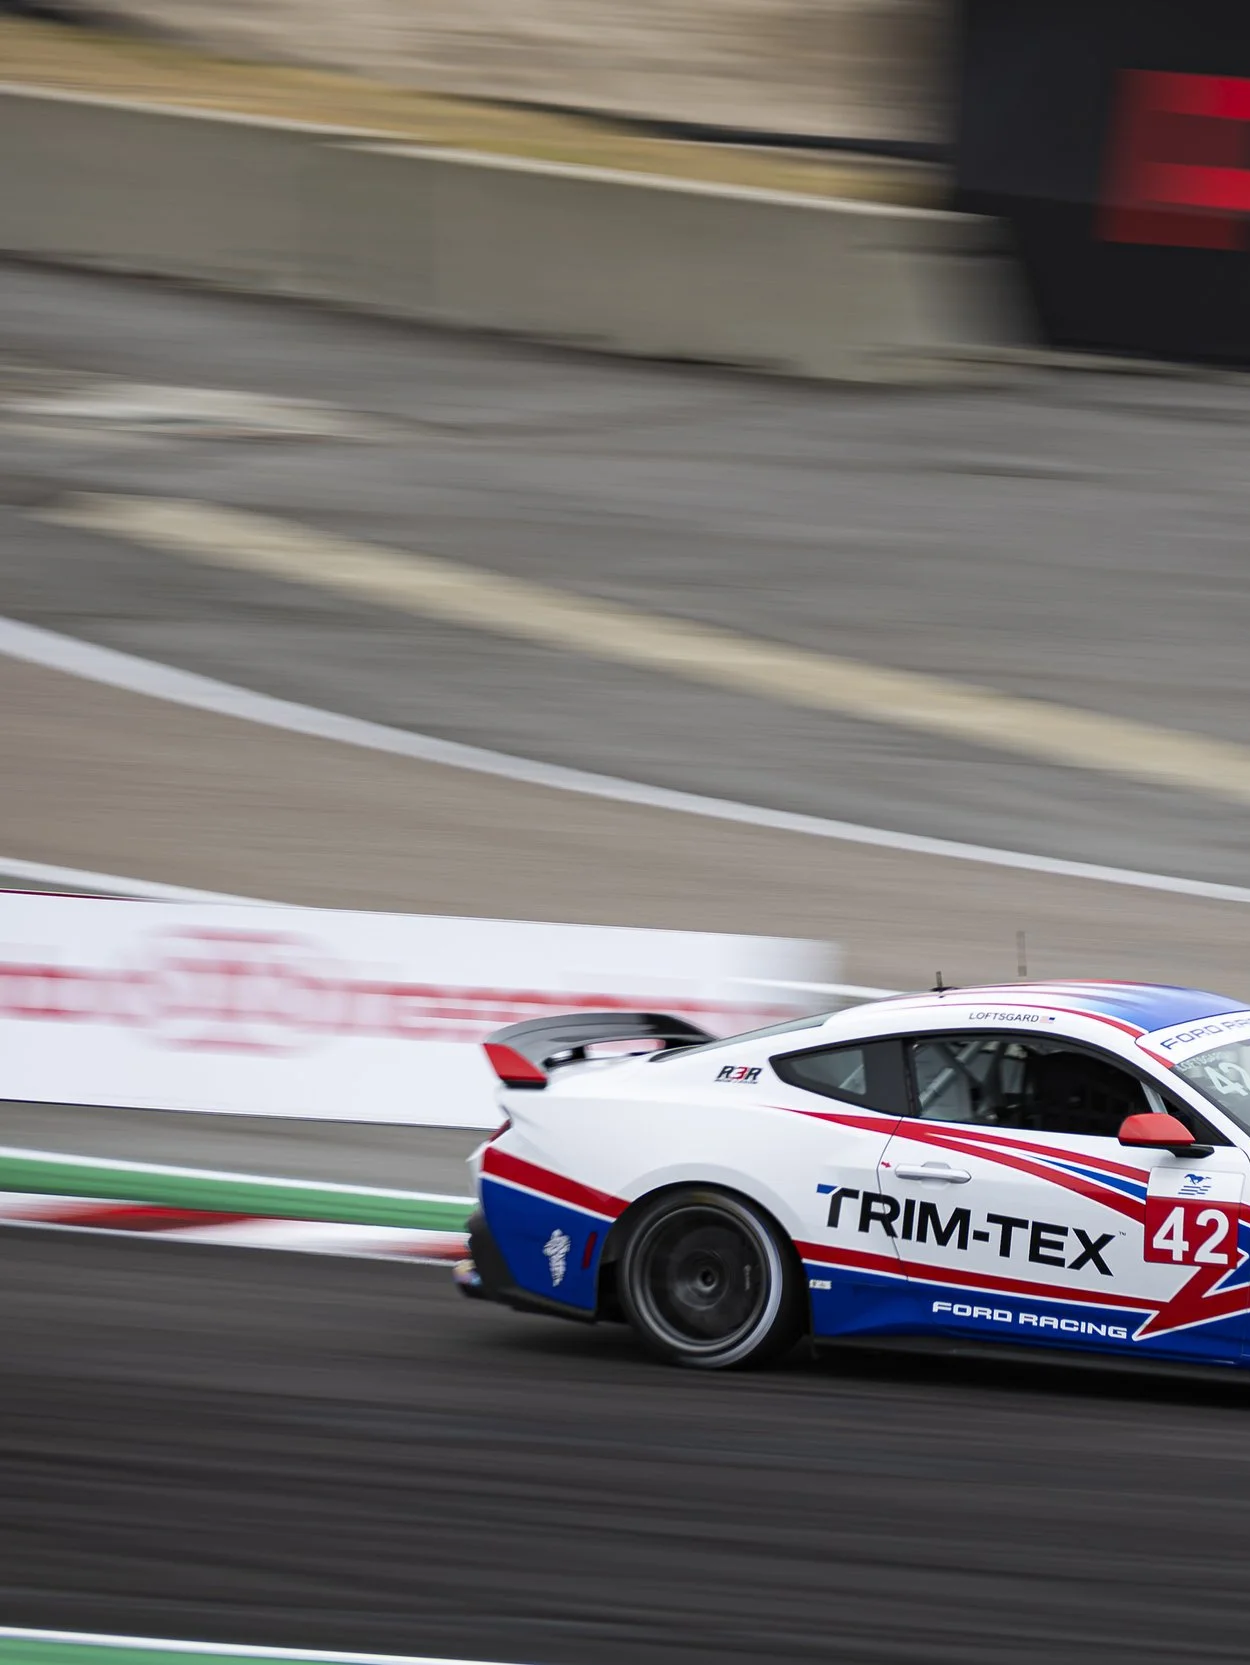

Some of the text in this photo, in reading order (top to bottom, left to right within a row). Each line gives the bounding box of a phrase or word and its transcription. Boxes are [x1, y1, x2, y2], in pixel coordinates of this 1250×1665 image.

[968, 1012, 1040, 1023] LOFTSGARD
[1160, 1024, 1224, 1050] FORD
[716, 1065, 763, 1081] R3R
[816, 1183, 1116, 1277] TRIM-TEX
[1152, 1206, 1230, 1265] 42
[932, 1301, 1128, 1339] FORD RACING
